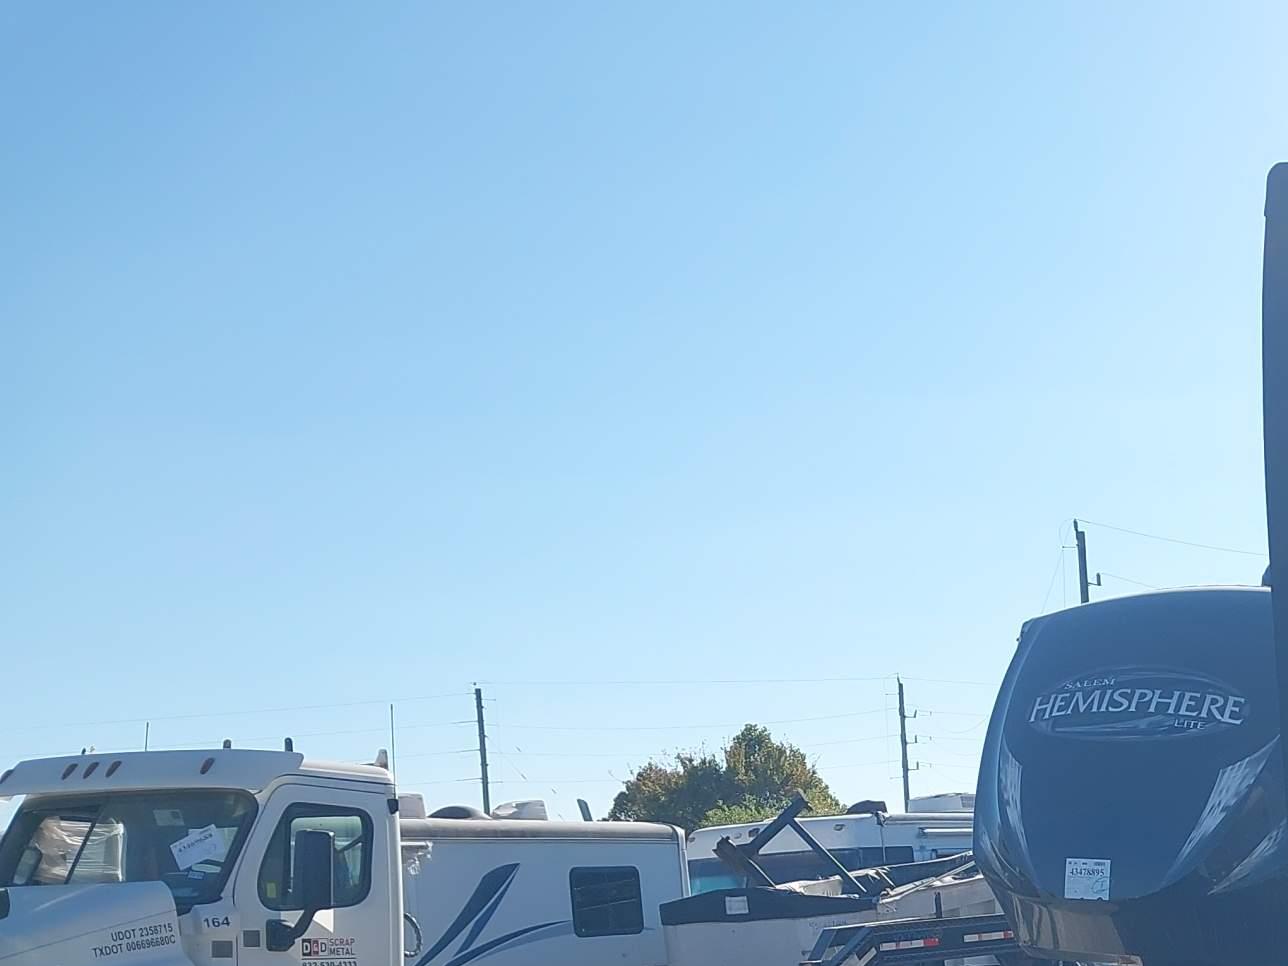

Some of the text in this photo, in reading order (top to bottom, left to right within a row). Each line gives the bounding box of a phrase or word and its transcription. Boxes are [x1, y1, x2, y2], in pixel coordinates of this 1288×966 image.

[1064, 677, 1116, 690] SALEM
[1029, 688, 1246, 725] HEMISPHERE
[1174, 718, 1206, 730] LITE
[203, 916, 231, 928] 164
[110, 928, 137, 942] UDOT
[329, 937, 355, 946] SCRAP
[92, 942, 124, 958] TXDOT
[329, 947, 356, 956] METAL
